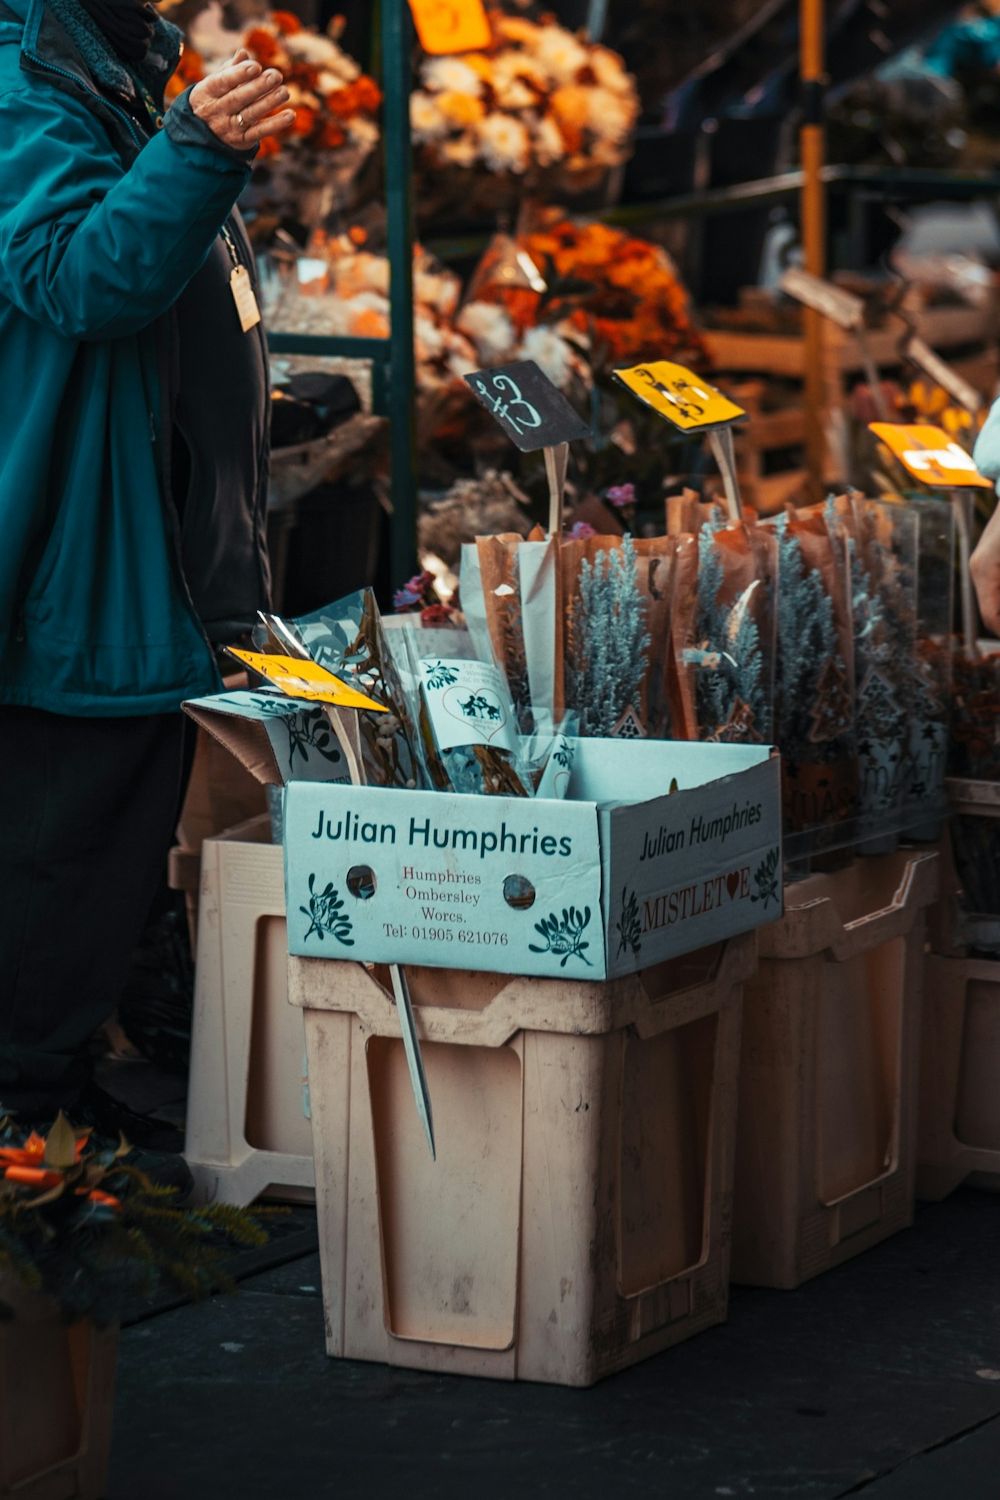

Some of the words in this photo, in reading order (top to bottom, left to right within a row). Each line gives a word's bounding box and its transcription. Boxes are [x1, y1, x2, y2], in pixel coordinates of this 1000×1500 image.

[476, 375, 542, 435] £3
[311, 810, 396, 844] Julian
[408, 817, 572, 858] Humphries
[639, 826, 685, 861] Julian
[689, 801, 762, 846] Humphries
[403, 866, 482, 885] Humphries
[405, 885, 481, 907] Ombersley
[420, 906, 467, 923] Worcs.
[382, 923, 407, 938] Tel:
[412, 926, 454, 942] 01905
[458, 930, 509, 946] 621076
